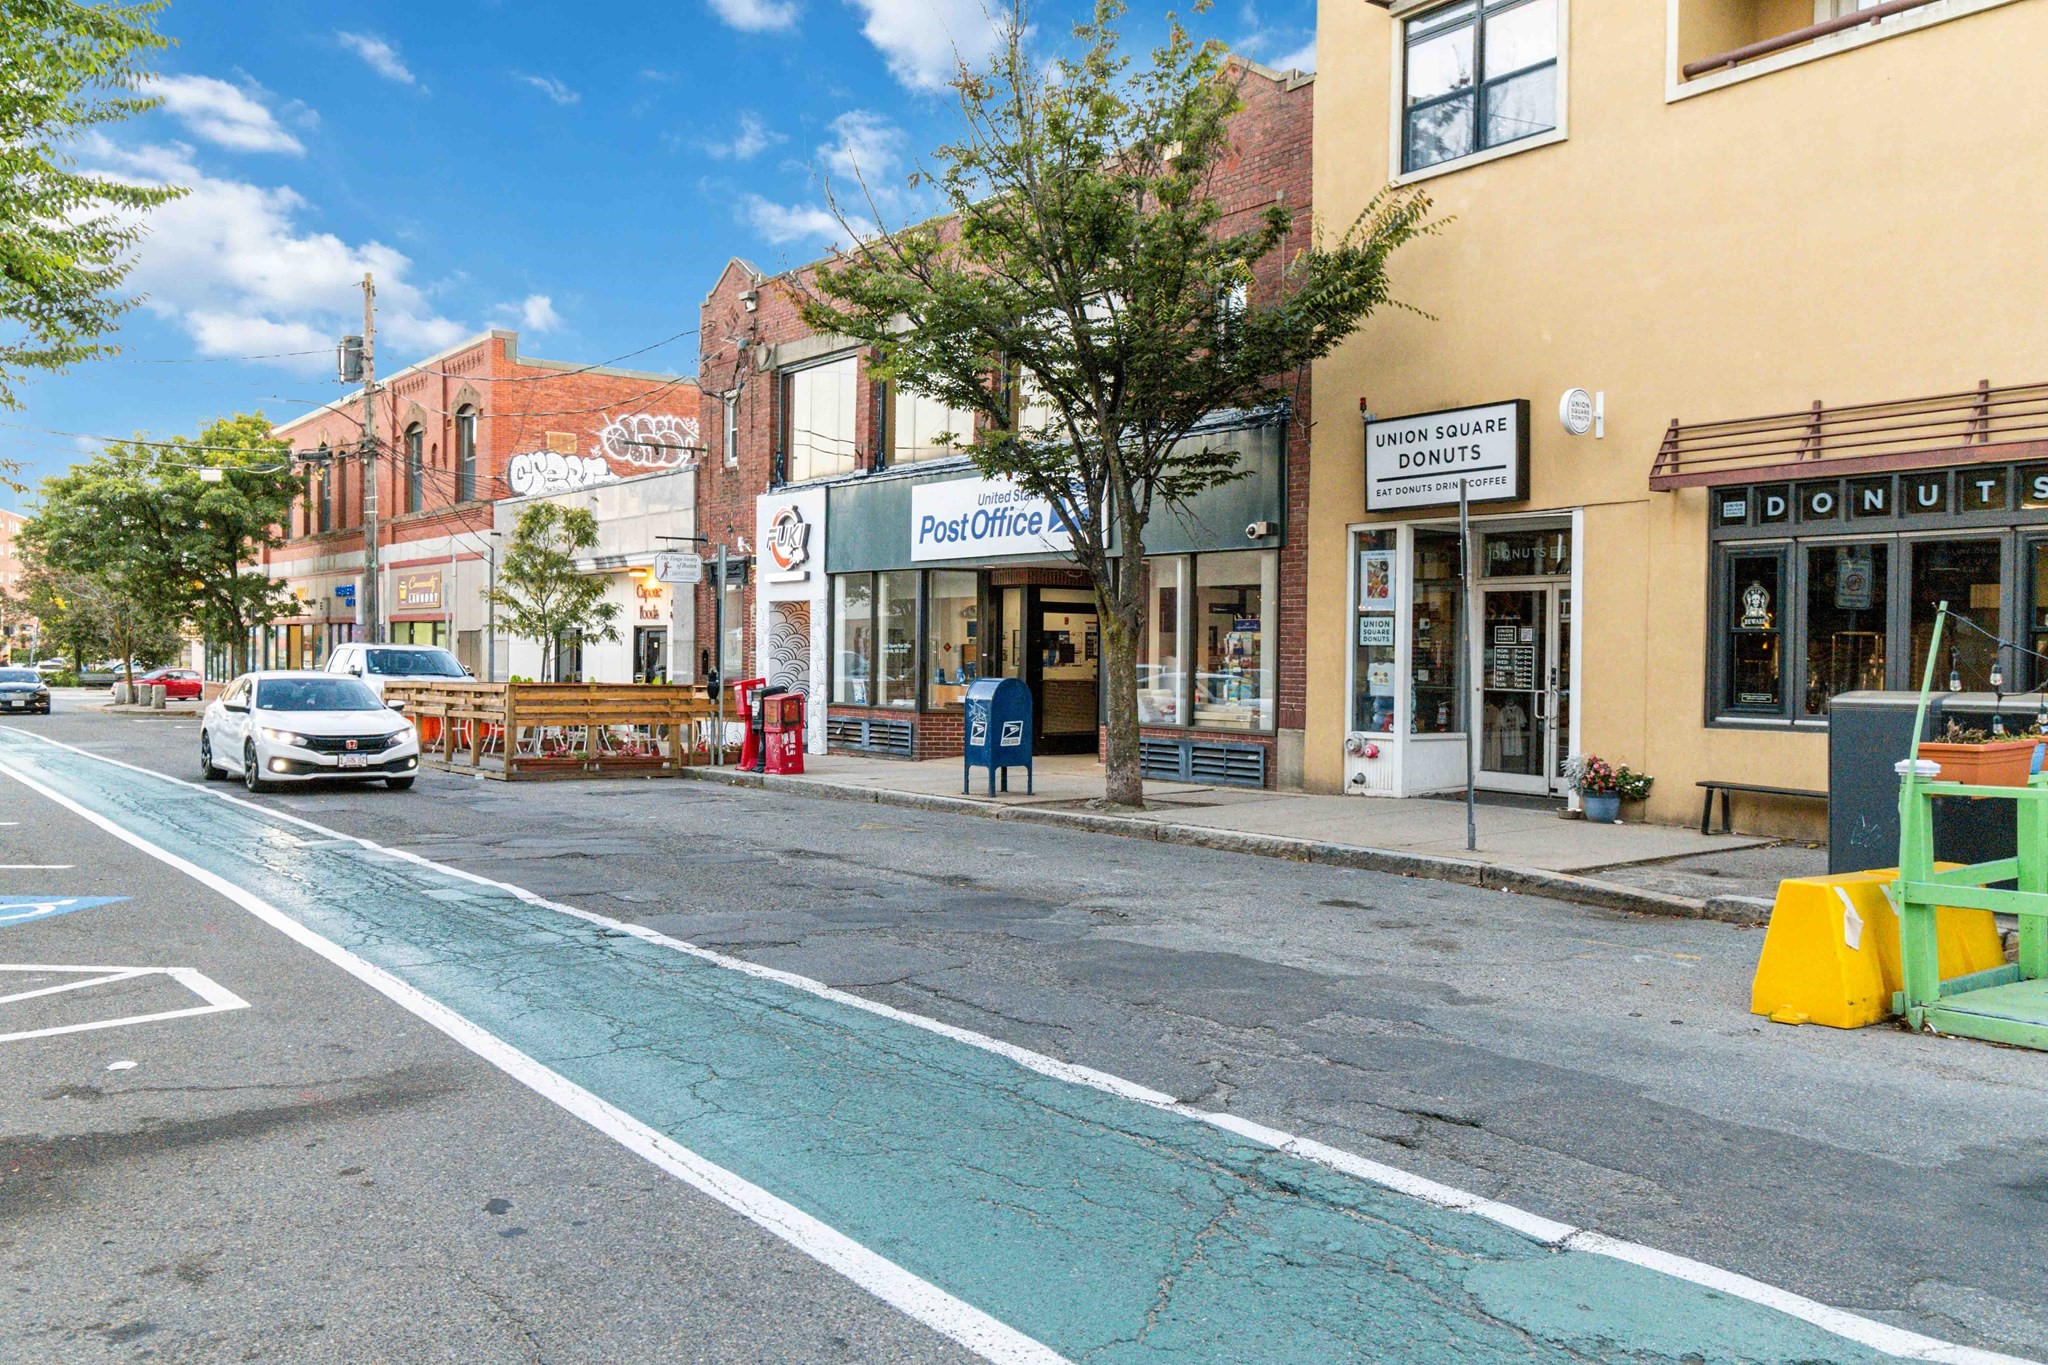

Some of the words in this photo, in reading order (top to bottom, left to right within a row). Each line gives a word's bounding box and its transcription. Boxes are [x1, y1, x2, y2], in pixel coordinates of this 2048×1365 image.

[1376, 428, 1428, 448] UNION
[1436, 418, 1507, 440] SQUARE
[1399, 444, 1481, 469] DONUTS
[977, 491, 1011, 506] United
[1376, 488, 1392, 497] EAT
[1396, 484, 1432, 494] DONUTS
[1436, 480, 1460, 491] DRIN
[1468, 476, 1507, 488] COFFEE
[1767, 475, 2048, 516] DONUTS
[766, 523, 805, 550] FUKI
[919, 512, 969, 545] Post
[971, 506, 1043, 540] Office
[1492, 547, 1547, 560] DONUTS
